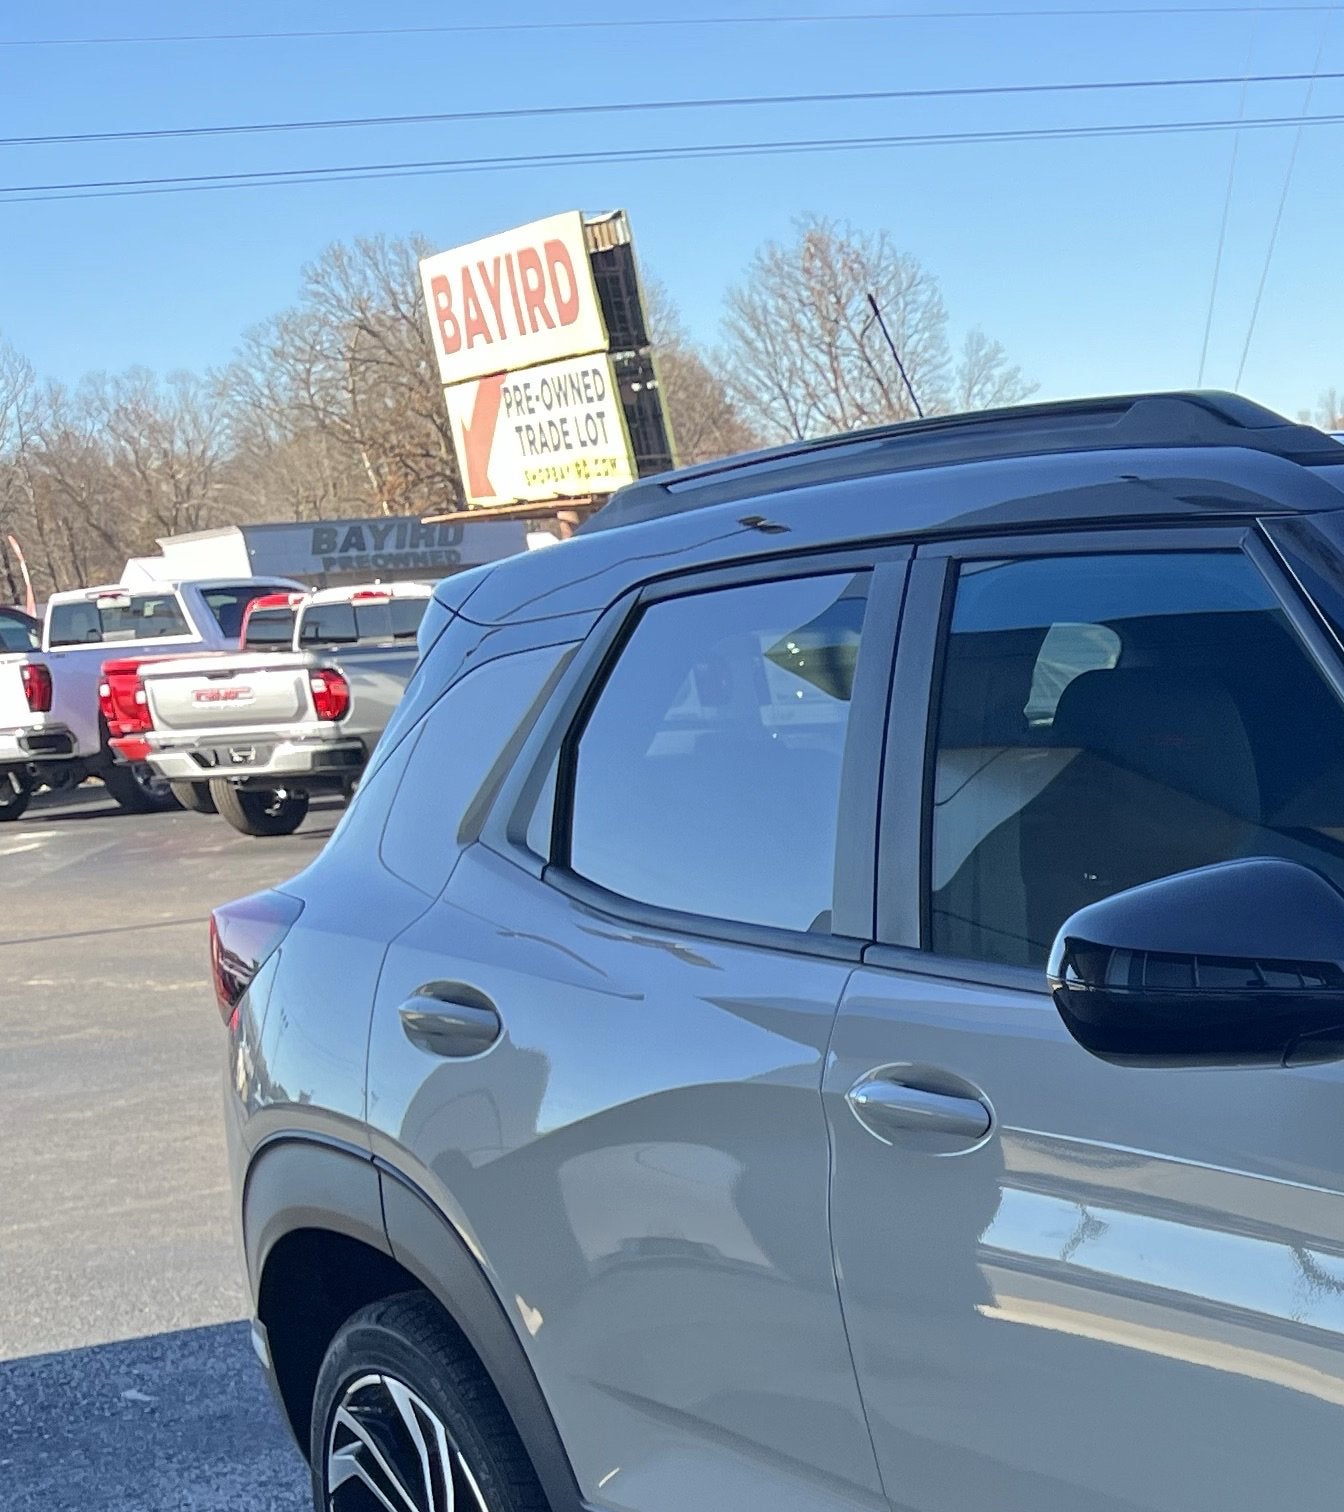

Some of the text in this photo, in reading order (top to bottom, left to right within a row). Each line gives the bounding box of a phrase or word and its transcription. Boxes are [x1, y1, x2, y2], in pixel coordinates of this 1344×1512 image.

[430, 238, 580, 355] BAYIRD
[502, 367, 606, 418] PRE-OWNED
[515, 411, 609, 457] TRADE LOT
[311, 522, 465, 556] BAYIRD
[322, 549, 462, 572] PREOWNED
